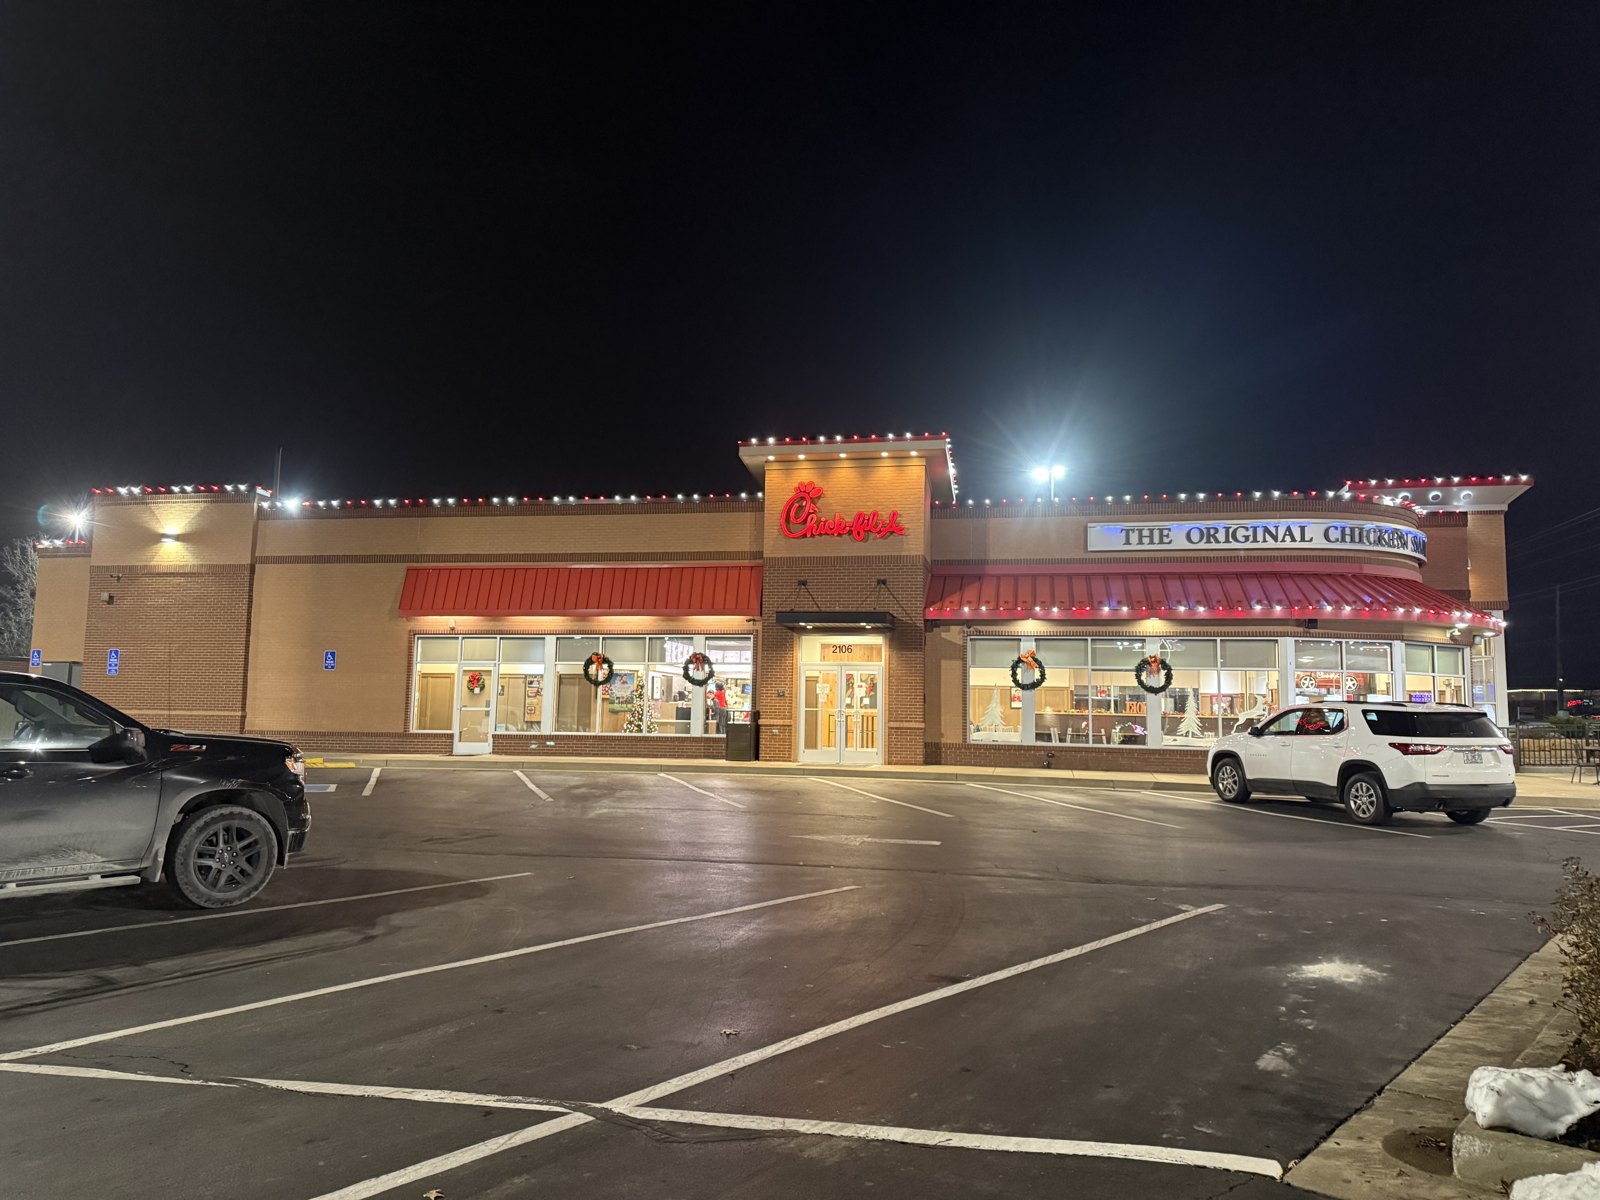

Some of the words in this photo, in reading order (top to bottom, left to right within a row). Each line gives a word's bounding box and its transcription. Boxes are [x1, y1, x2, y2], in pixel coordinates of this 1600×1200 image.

[781, 486, 905, 541] Chick-fil-A
[1120, 527, 1173, 546] THE
[1185, 525, 1313, 545] ORIGINAL
[1324, 525, 1409, 550] CHICKEN
[832, 644, 853, 654] 2106
